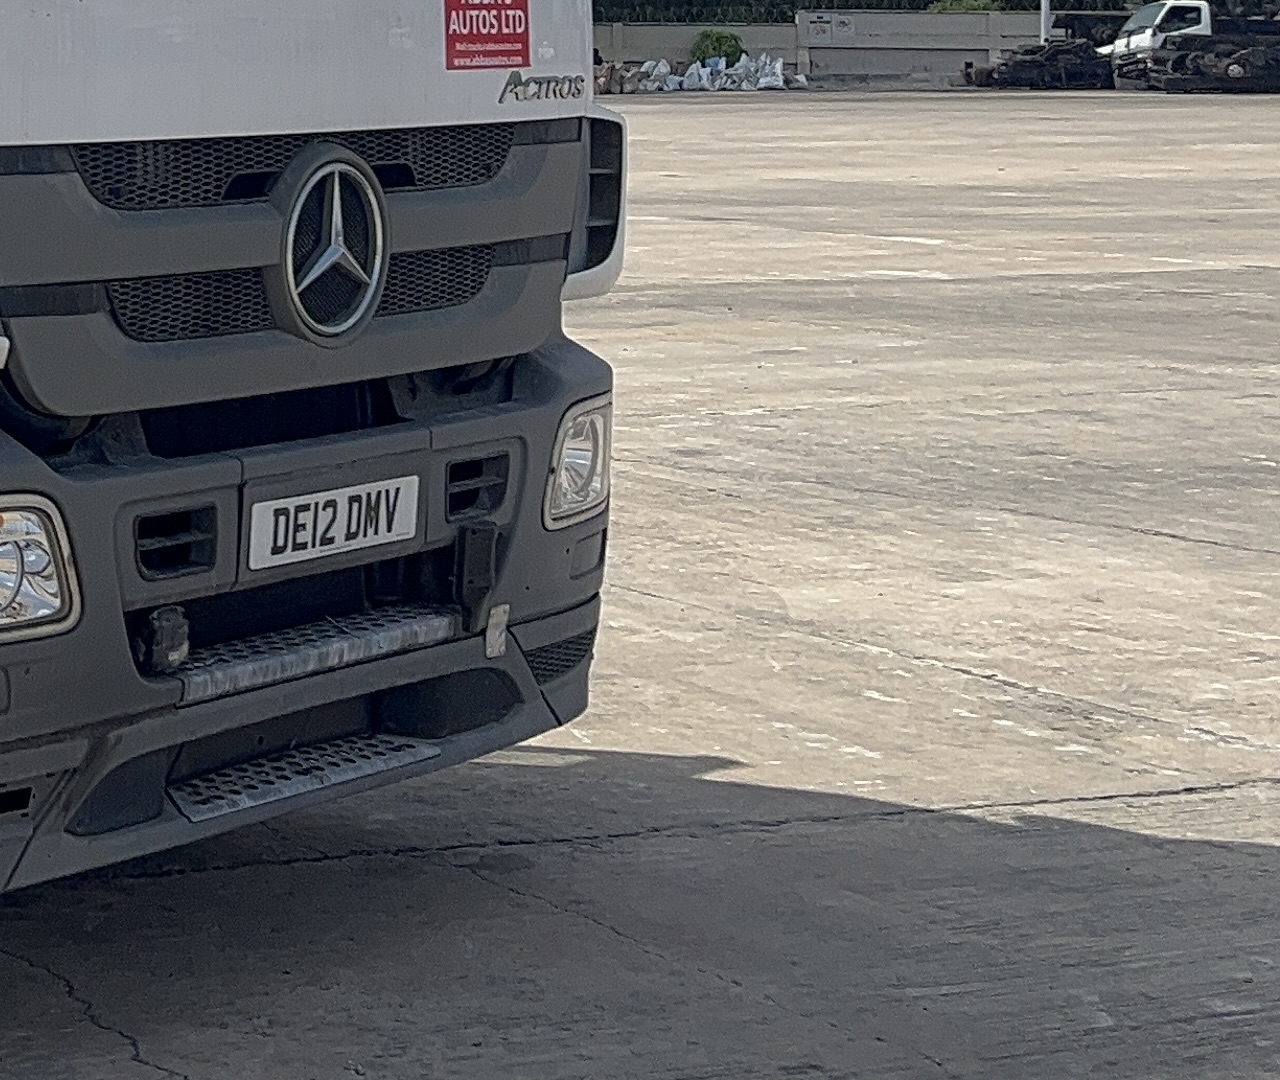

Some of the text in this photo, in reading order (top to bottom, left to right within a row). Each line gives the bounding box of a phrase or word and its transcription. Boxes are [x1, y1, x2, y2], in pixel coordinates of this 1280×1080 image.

[448, 9, 526, 35] AUTOS LTD
[271, 487, 400, 555] DE12 DMV
